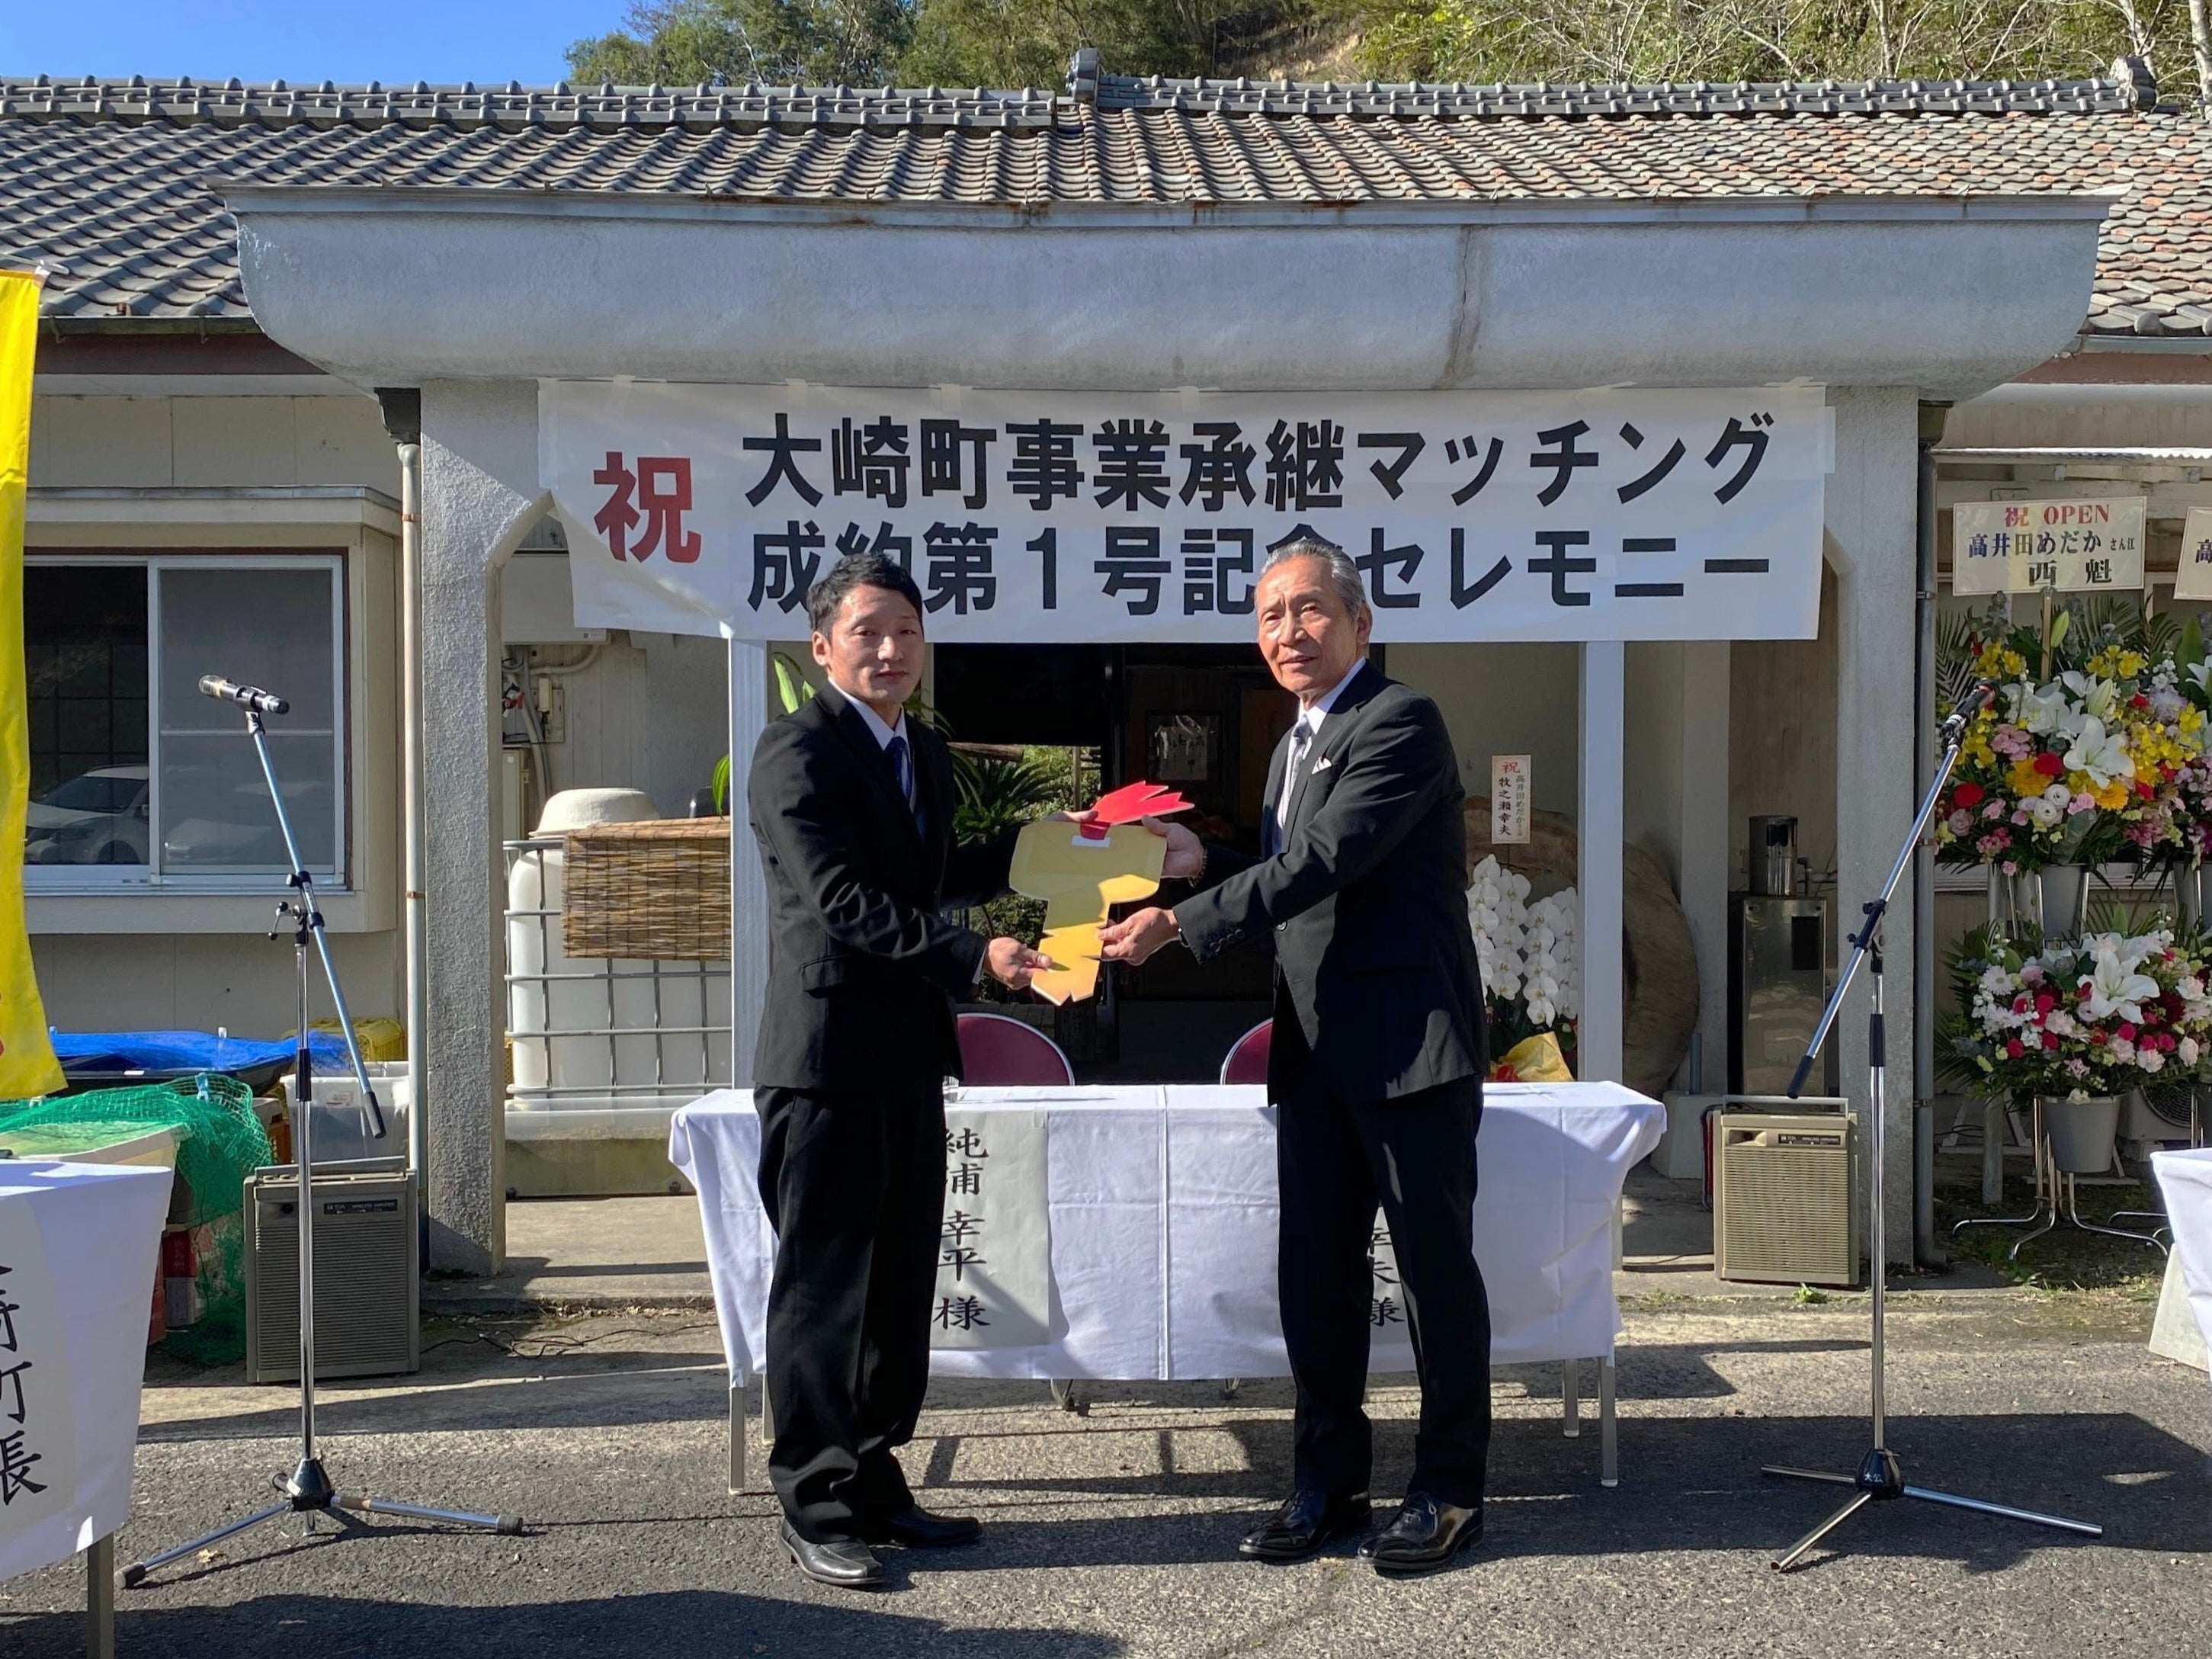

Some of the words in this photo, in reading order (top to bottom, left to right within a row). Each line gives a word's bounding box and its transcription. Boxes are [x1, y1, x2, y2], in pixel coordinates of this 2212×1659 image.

[593, 451, 702, 563] 祝
[742, 412, 1774, 512] 大崎町事業承継マッチング
[2005, 506, 2029, 527] 祝
[2044, 504, 2109, 525] OPEN
[747, 520, 1770, 616] 成第1号記セレモニー
[1502, 762, 1521, 774] 祝
